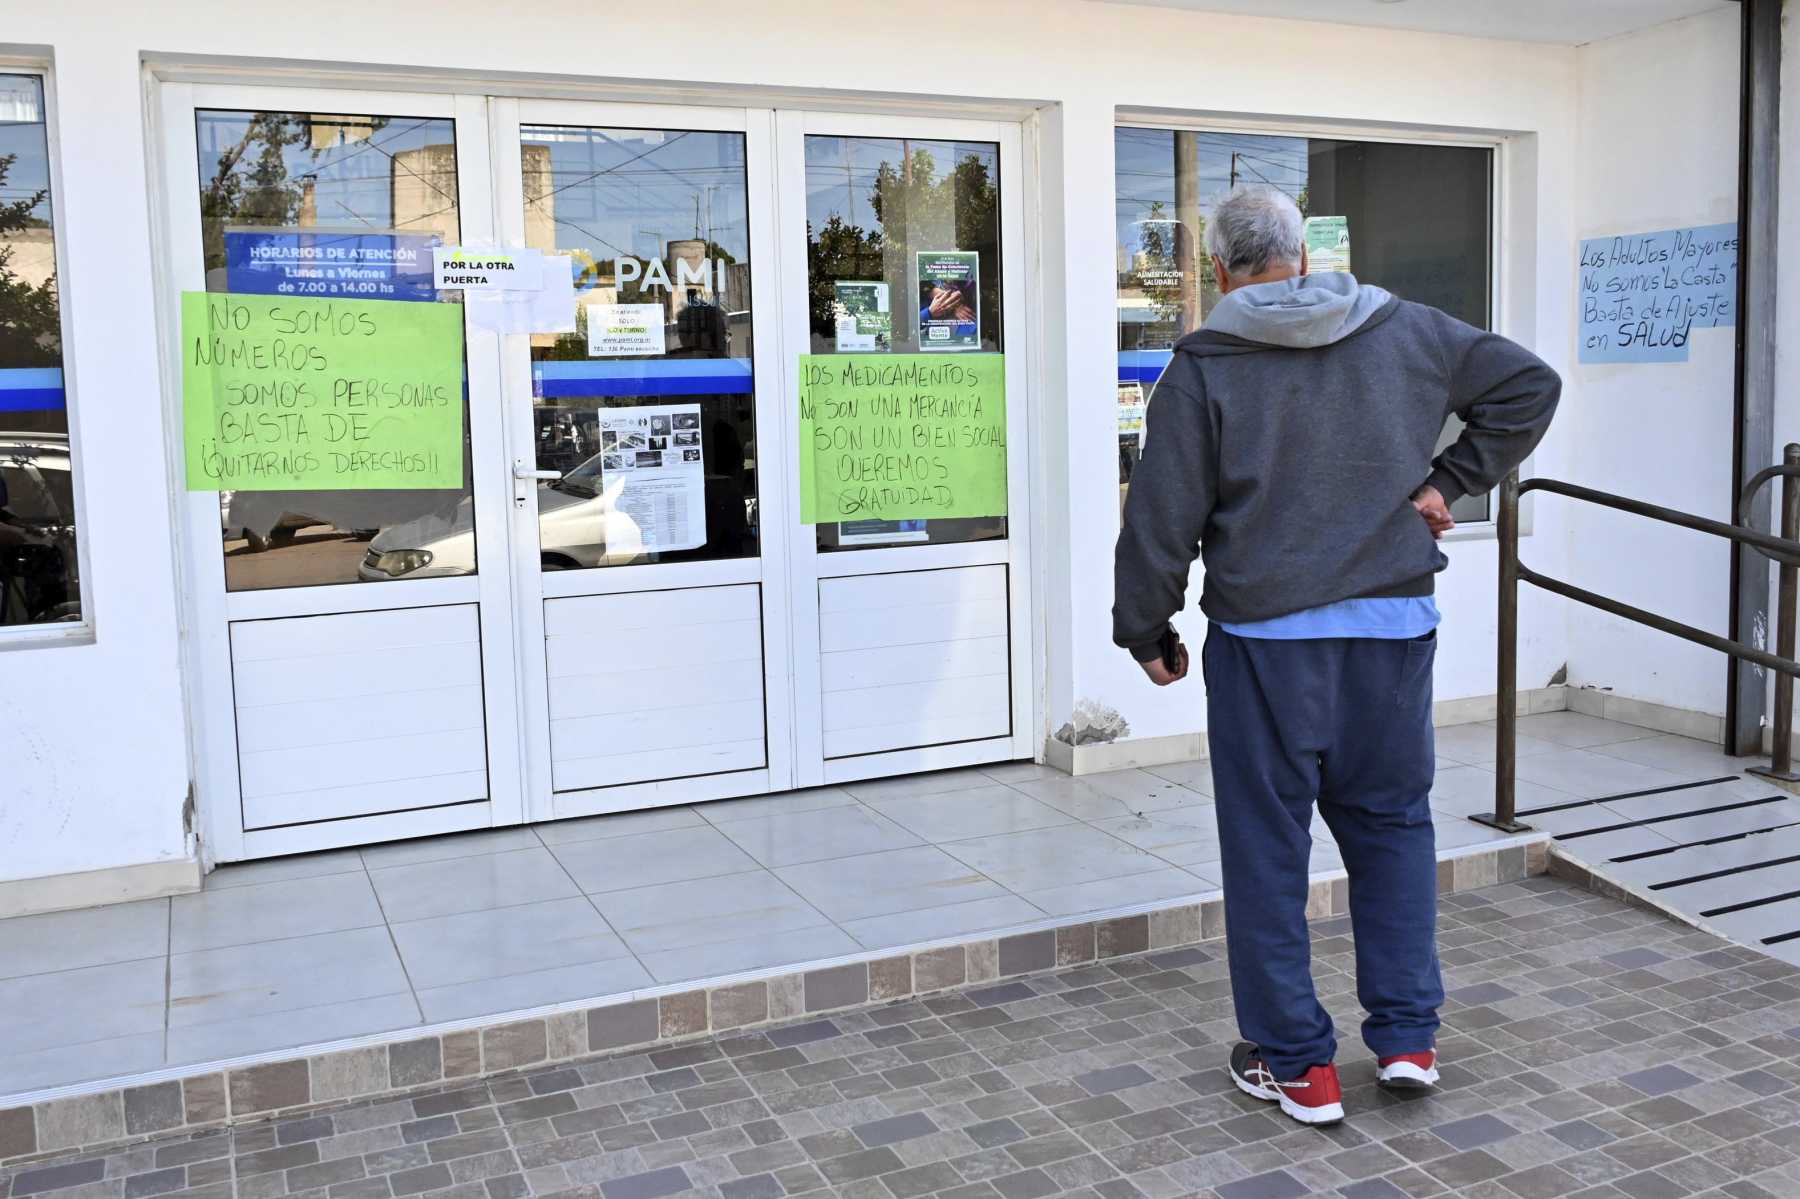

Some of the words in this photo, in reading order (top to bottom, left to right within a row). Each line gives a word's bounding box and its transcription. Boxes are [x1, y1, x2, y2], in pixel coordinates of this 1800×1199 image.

[250, 247, 323, 258] HORARIOS
[327, 248, 346, 259] DE
[349, 247, 417, 260] ATENCIÓN
[443, 261, 466, 270] POR
[469, 261, 483, 270] LA
[486, 261, 515, 271] OTRA
[1581, 244, 1605, 268] Los
[285, 267, 324, 278] Lunes
[327, 269, 336, 279] a
[338, 267, 386, 279] Viernes
[443, 275, 488, 285] PUERTA
[614, 256, 726, 292] PAMI
[1583, 271, 1599, 293] No
[278, 281, 295, 293] de
[298, 281, 327, 293] 7.00
[330, 284, 338, 293] a
[341, 282, 377, 294] 14.00
[380, 283, 395, 294] hs
[211, 297, 251, 331] NO
[269, 303, 378, 336] SOMOS
[1584, 296, 1634, 323] Basta
[1641, 296, 1661, 320] de
[194, 334, 328, 371] NÚMEROS
[1586, 334, 1609, 351] en
[805, 363, 834, 387] LOS
[842, 361, 979, 388] MEDICAMENTOS
[225, 379, 317, 409] SOMOS
[333, 378, 449, 409] PERSONAS
[825, 398, 858, 419] SON
[871, 393, 902, 419] UNA
[220, 411, 311, 444] BASTA
[321, 412, 372, 442] DE
[815, 425, 862, 451] SON
[873, 425, 902, 449] UN
[913, 424, 956, 449] BIEN
[961, 425, 1006, 448] SOCIAL
[837, 452, 949, 482] QUEREMOS
